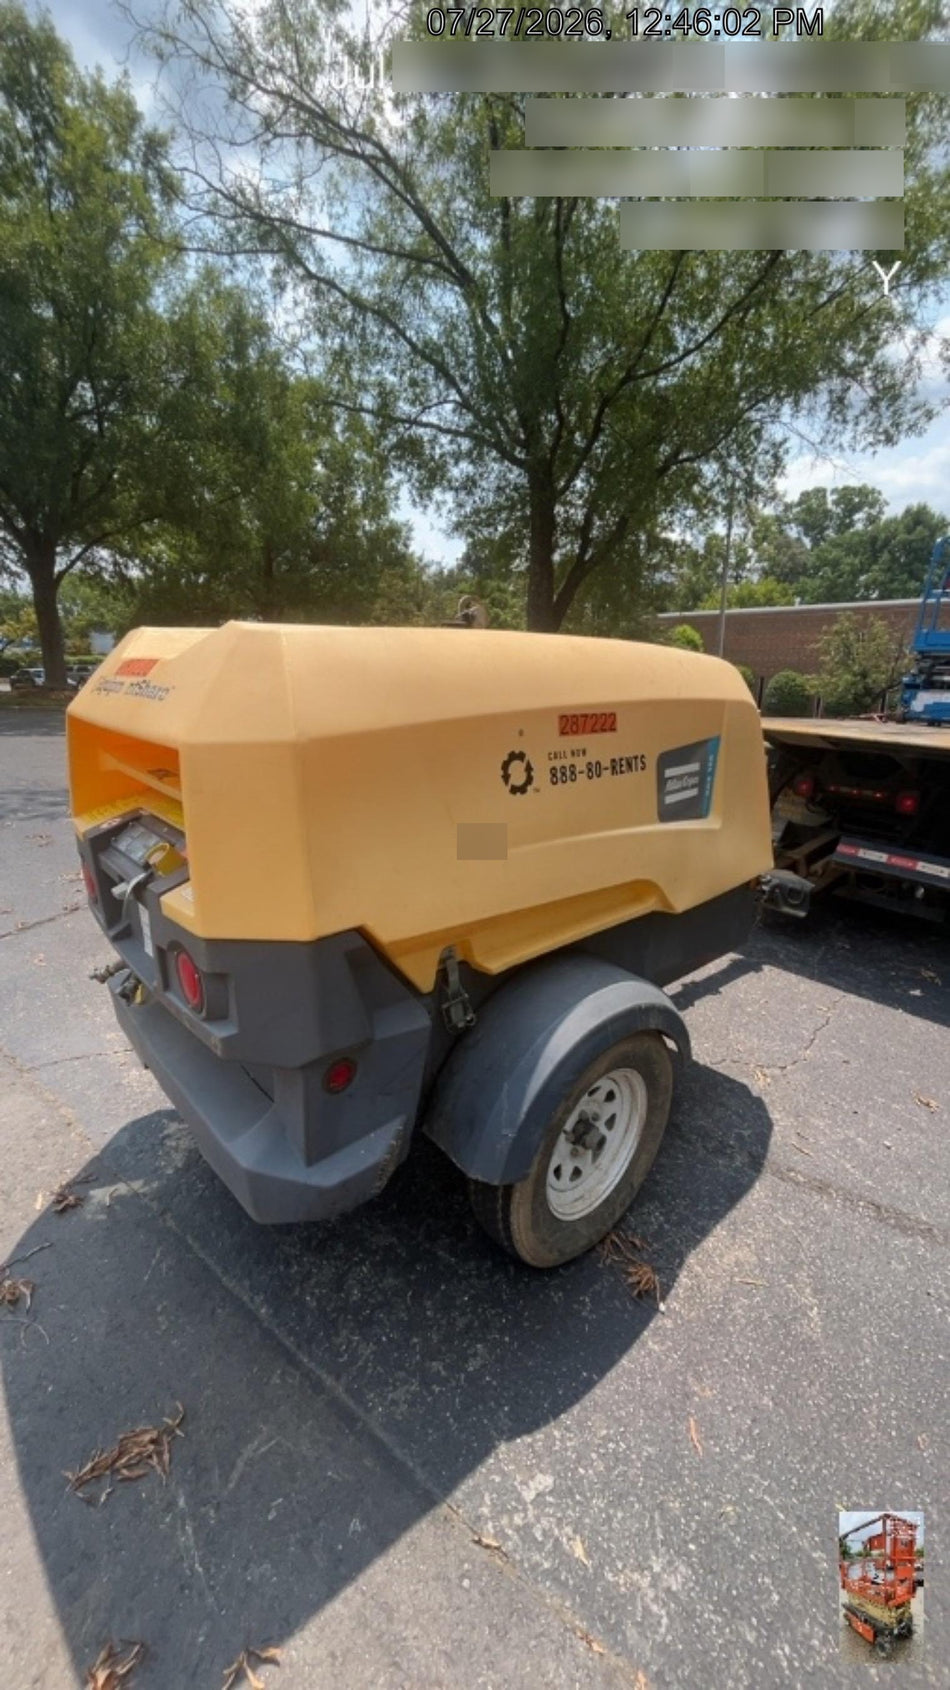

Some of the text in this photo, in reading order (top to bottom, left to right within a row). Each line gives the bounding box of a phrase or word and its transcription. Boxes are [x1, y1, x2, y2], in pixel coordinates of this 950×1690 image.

[558, 712, 617, 735] 287222
[547, 748, 587, 761] CALL NOW
[549, 754, 647, 786] 888-80-RENTS
